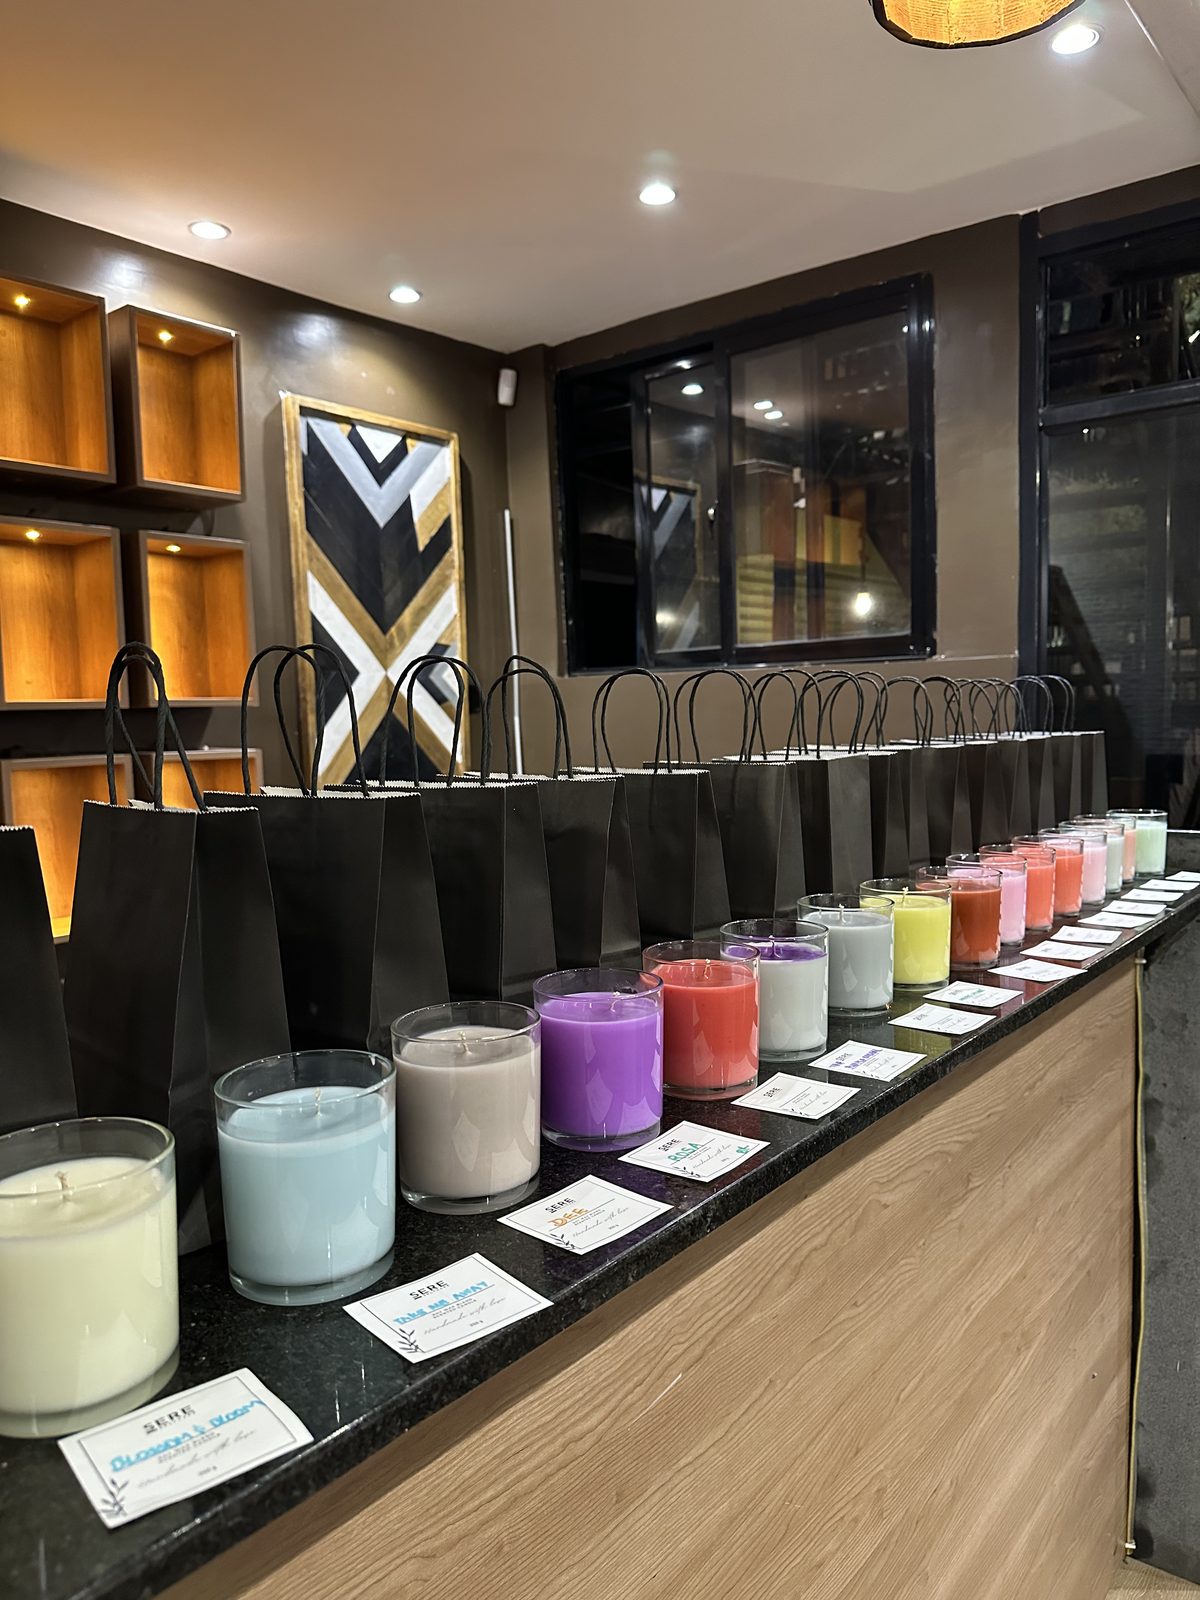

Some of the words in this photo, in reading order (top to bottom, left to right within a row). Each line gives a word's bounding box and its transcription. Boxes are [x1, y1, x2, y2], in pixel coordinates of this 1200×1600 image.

[658, 1139, 680, 1151] SERE
[667, 1142, 704, 1161] ROSA
[545, 1198, 574, 1213] SERE
[547, 1208, 589, 1227] DEE
[409, 1280, 447, 1299] SERE
[393, 1308, 428, 1325] TAKE
[453, 1281, 488, 1300] AWAY
[143, 1405, 193, 1430] SERE
